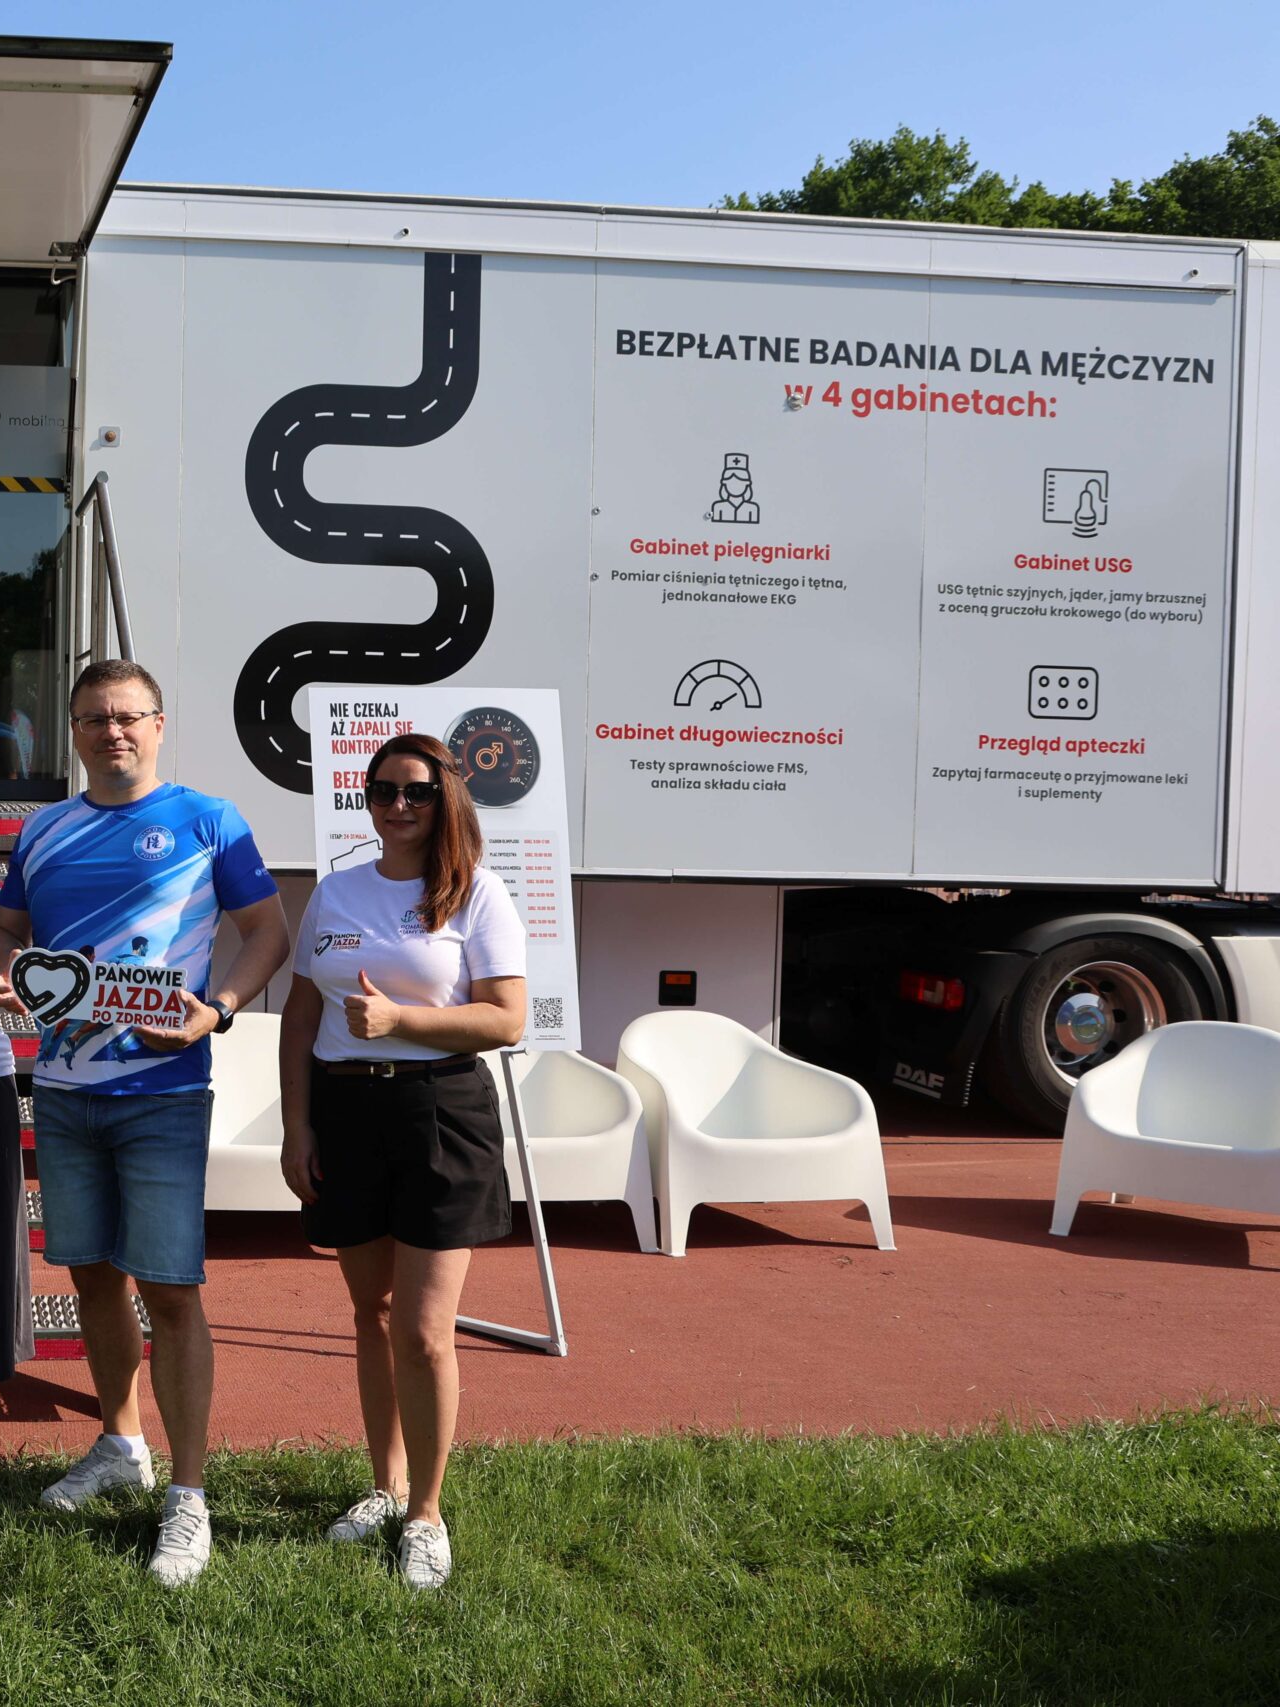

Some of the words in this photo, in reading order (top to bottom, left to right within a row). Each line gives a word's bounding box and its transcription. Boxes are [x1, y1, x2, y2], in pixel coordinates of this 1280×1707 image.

[616, 329, 800, 363] BEZPŁATNE
[809, 339, 961, 372] BADANIA
[970, 347, 1032, 375] DLA
[1041, 346, 1214, 385] MĘŻCZYZN
[822, 381, 842, 407] 4
[851, 383, 1057, 418] gabinetach:
[9, 415, 64, 427] mobilna
[630, 538, 709, 557] Gabinet
[714, 540, 831, 563] pielęgniarki
[1014, 553, 1089, 571] Gabinet
[1095, 557, 1133, 573] USG
[611, 570, 661, 582] Pomiar
[663, 571, 726, 585] ciśnienia
[729, 574, 800, 590] tętniczego
[802, 576, 806, 588] i
[808, 577, 848, 591] tętna,
[662, 589, 768, 604] jednokanałowe
[770, 594, 797, 605] EKG
[938, 584, 964, 595] USG
[966, 585, 1004, 599] tętnic
[1007, 587, 1067, 601] szyjnych,
[1069, 588, 1107, 603] jąder,
[1109, 590, 1142, 605] jamy
[1145, 592, 1207, 607] brzusznej
[939, 602, 946, 613] z
[948, 604, 988, 617] oceną
[991, 603, 1047, 618] gruczołu
[1050, 606, 1121, 622] krokowego
[1125, 606, 1146, 623] (do
[1149, 608, 1203, 624] wyboru)
[330, 703, 349, 717] NIE
[354, 703, 399, 717] CZEKAJ
[331, 719, 345, 735] AŻ
[350, 721, 390, 735] ZAPALI
[595, 724, 674, 741] Gabinet
[679, 725, 843, 747] długowieczności
[978, 735, 1061, 756] Przegląd
[1065, 737, 1145, 757] apteczki
[630, 759, 665, 773] Testy
[668, 760, 775, 775] sprawnościowe
[777, 763, 808, 776] FMS,
[932, 767, 981, 782] Zapytaj
[984, 767, 1061, 783] farmaceutę
[1064, 773, 1072, 781] o
[1074, 770, 1163, 786] przyjmowane
[1165, 773, 1188, 785] leki
[651, 778, 701, 790] analiza
[704, 778, 750, 791] składu
[753, 779, 787, 791] ciała
[1018, 787, 1022, 798] i
[1024, 788, 1102, 803] suplementy
[333, 938, 360, 947] JAZDA
[95, 965, 182, 987] PANOWIE
[93, 984, 182, 1013] JAZDA
[92, 1010, 111, 1022] PO
[116, 1012, 180, 1028] ZDROWIE
[895, 1062, 944, 1089] DAF
